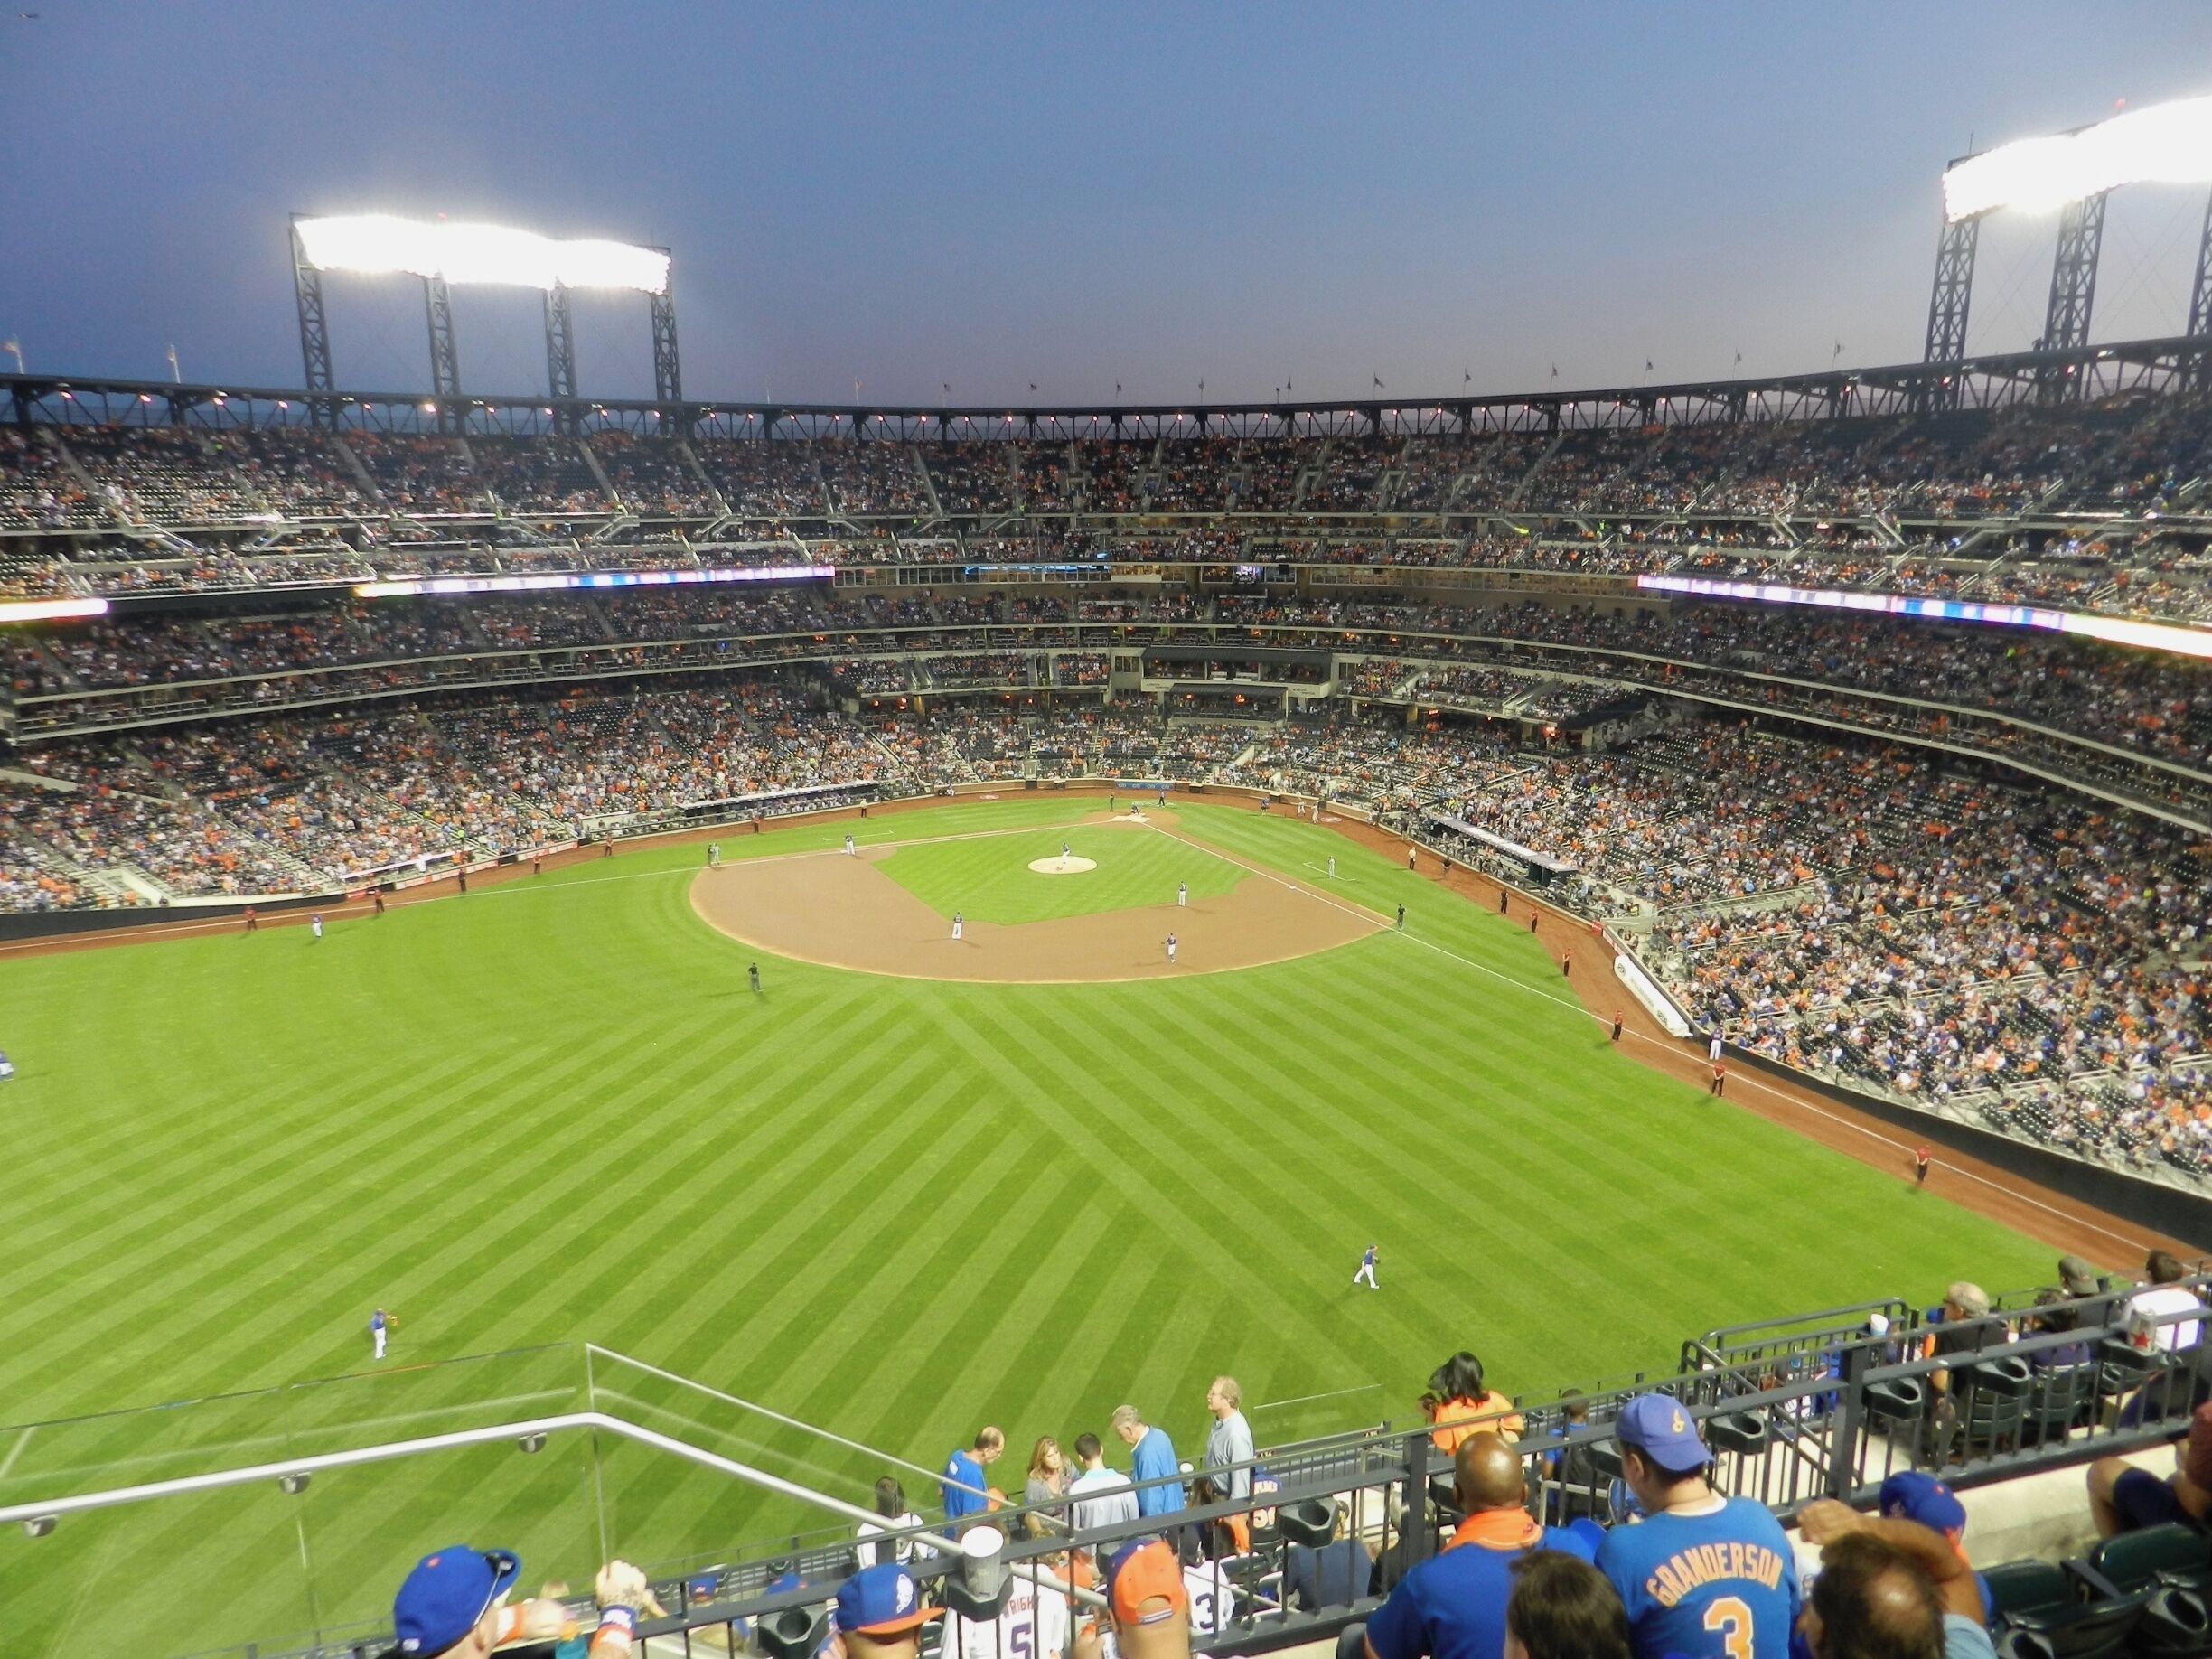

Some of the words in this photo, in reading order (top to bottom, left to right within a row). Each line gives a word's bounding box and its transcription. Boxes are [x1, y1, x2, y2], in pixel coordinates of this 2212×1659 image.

[1646, 1542, 1784, 1607] GRANDERSON
[1002, 1594, 1040, 1618] RIGH
[1195, 1592, 1216, 1629] 3
[1010, 1622, 1032, 1659] 5
[1703, 1596, 1754, 1659] 3
